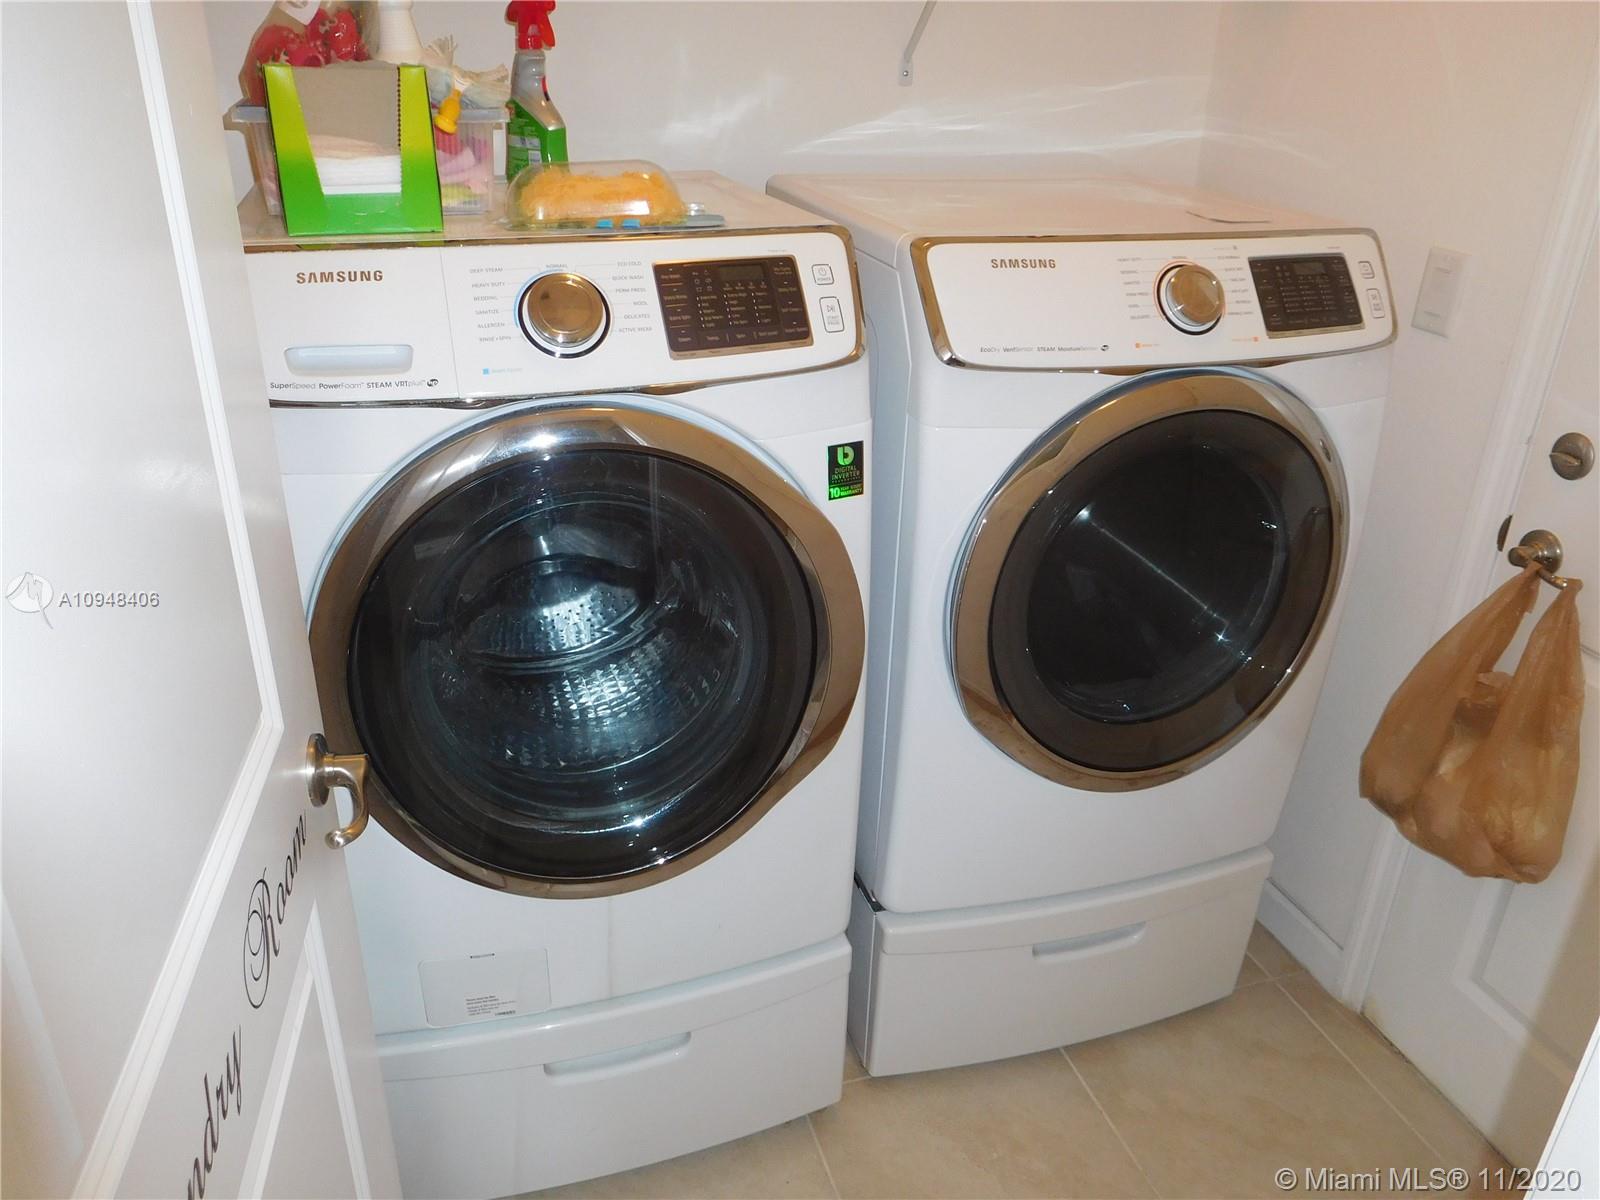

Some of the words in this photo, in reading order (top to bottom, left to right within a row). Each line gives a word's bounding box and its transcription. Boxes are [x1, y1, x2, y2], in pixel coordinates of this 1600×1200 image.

[991, 258, 1056, 269] SAMSUNG
[296, 269, 384, 285] SAMSUNG
[270, 381, 316, 390] SuperSpeed
[366, 380, 393, 389] STEAM
[834, 465, 857, 474] DIGITAL
[831, 470, 860, 481] INVERTER
[829, 486, 841, 499] 10
[243, 811, 306, 1010] Room
